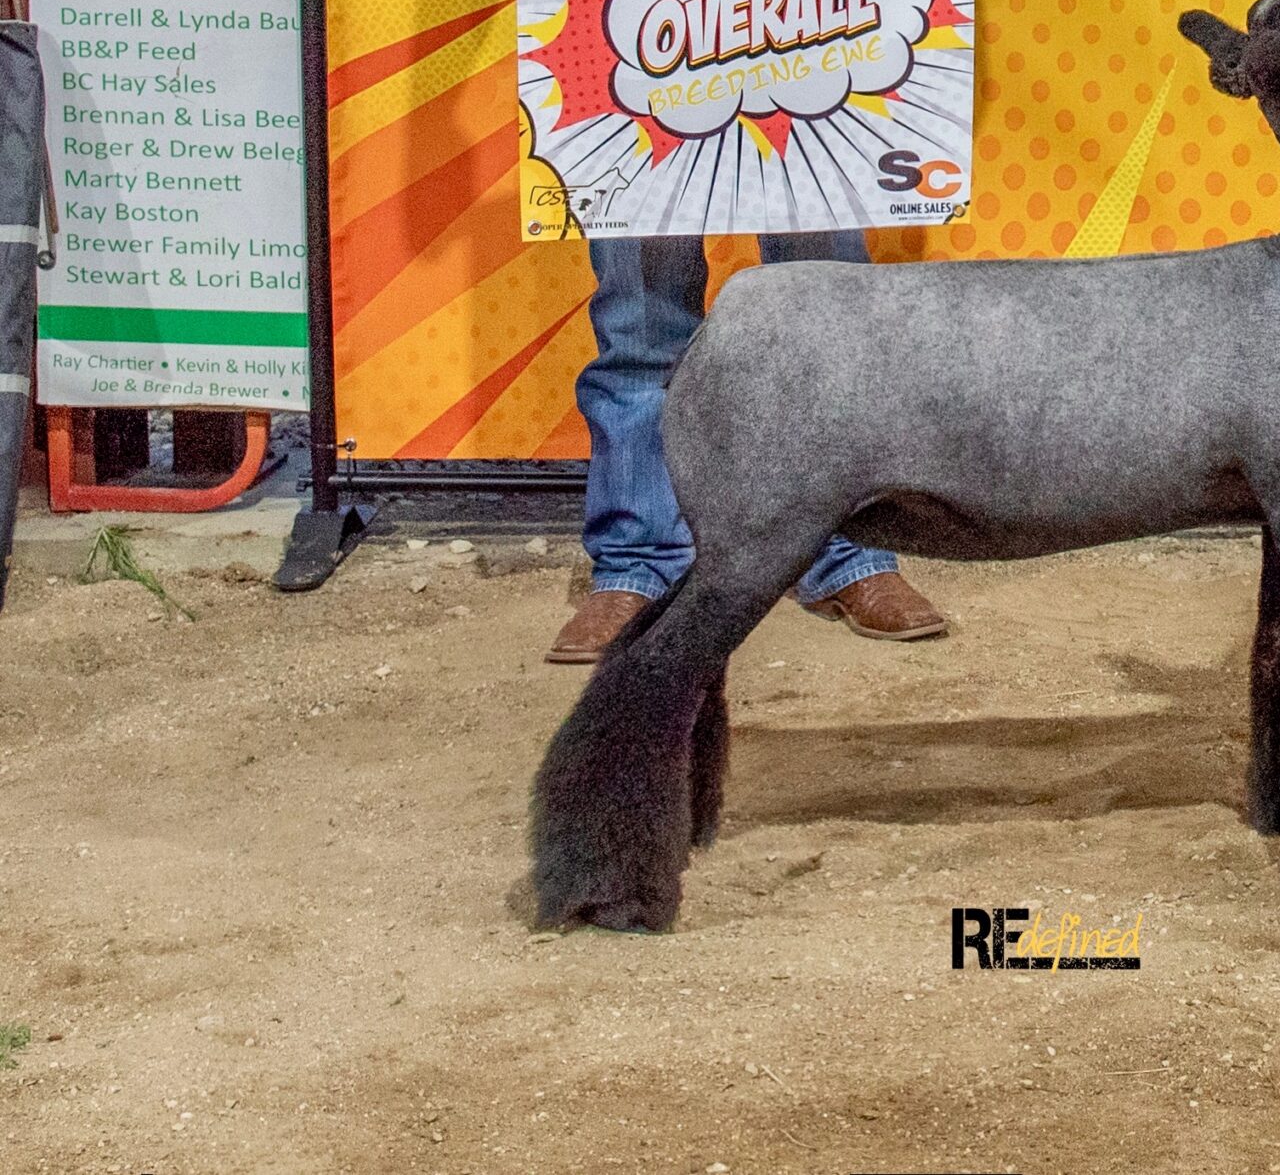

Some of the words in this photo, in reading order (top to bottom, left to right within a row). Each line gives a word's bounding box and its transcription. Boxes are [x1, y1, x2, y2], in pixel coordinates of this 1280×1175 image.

[61, 8, 142, 27] Darrell
[151, 10, 169, 28] &
[179, 11, 250, 33] Lynda
[62, 40, 129, 59] BB&P
[138, 42, 196, 61] Feed
[63, 73, 94, 92] BC
[102, 74, 146, 96] Hay
[154, 74, 217, 95] Sales
[648, 56, 813, 116] BREEDING
[821, 35, 886, 72] EWE
[64, 105, 165, 125] Brennan
[174, 108, 192, 126] &
[202, 109, 246, 128] Lisa
[64, 137, 134, 160] Roger
[142, 139, 161, 158] &
[170, 140, 234, 159] Drew
[65, 170, 137, 192] Marty
[147, 172, 243, 192] Bennett
[877, 149, 962, 199] SC
[65, 202, 107, 223] Kay
[116, 203, 200, 223] Boston
[890, 203, 923, 215] ONLINE
[925, 202, 951, 214] SALES
[67, 234, 154, 255] Brewer
[162, 236, 240, 261] Family
[67, 265, 160, 286] Stewart
[169, 268, 187, 286] &
[197, 270, 240, 289] Lori
[250, 271, 305, 291] Bald
[53, 354, 82, 371] Ray
[88, 355, 154, 371] Chartier
[177, 358, 221, 373] Kevin
[226, 360, 238, 374] &
[245, 360, 286, 378] Holly
[91, 378, 119, 393] Joe
[124, 379, 137, 392] &
[143, 380, 204, 396] Brenda
[209, 384, 269, 398] Brewer
